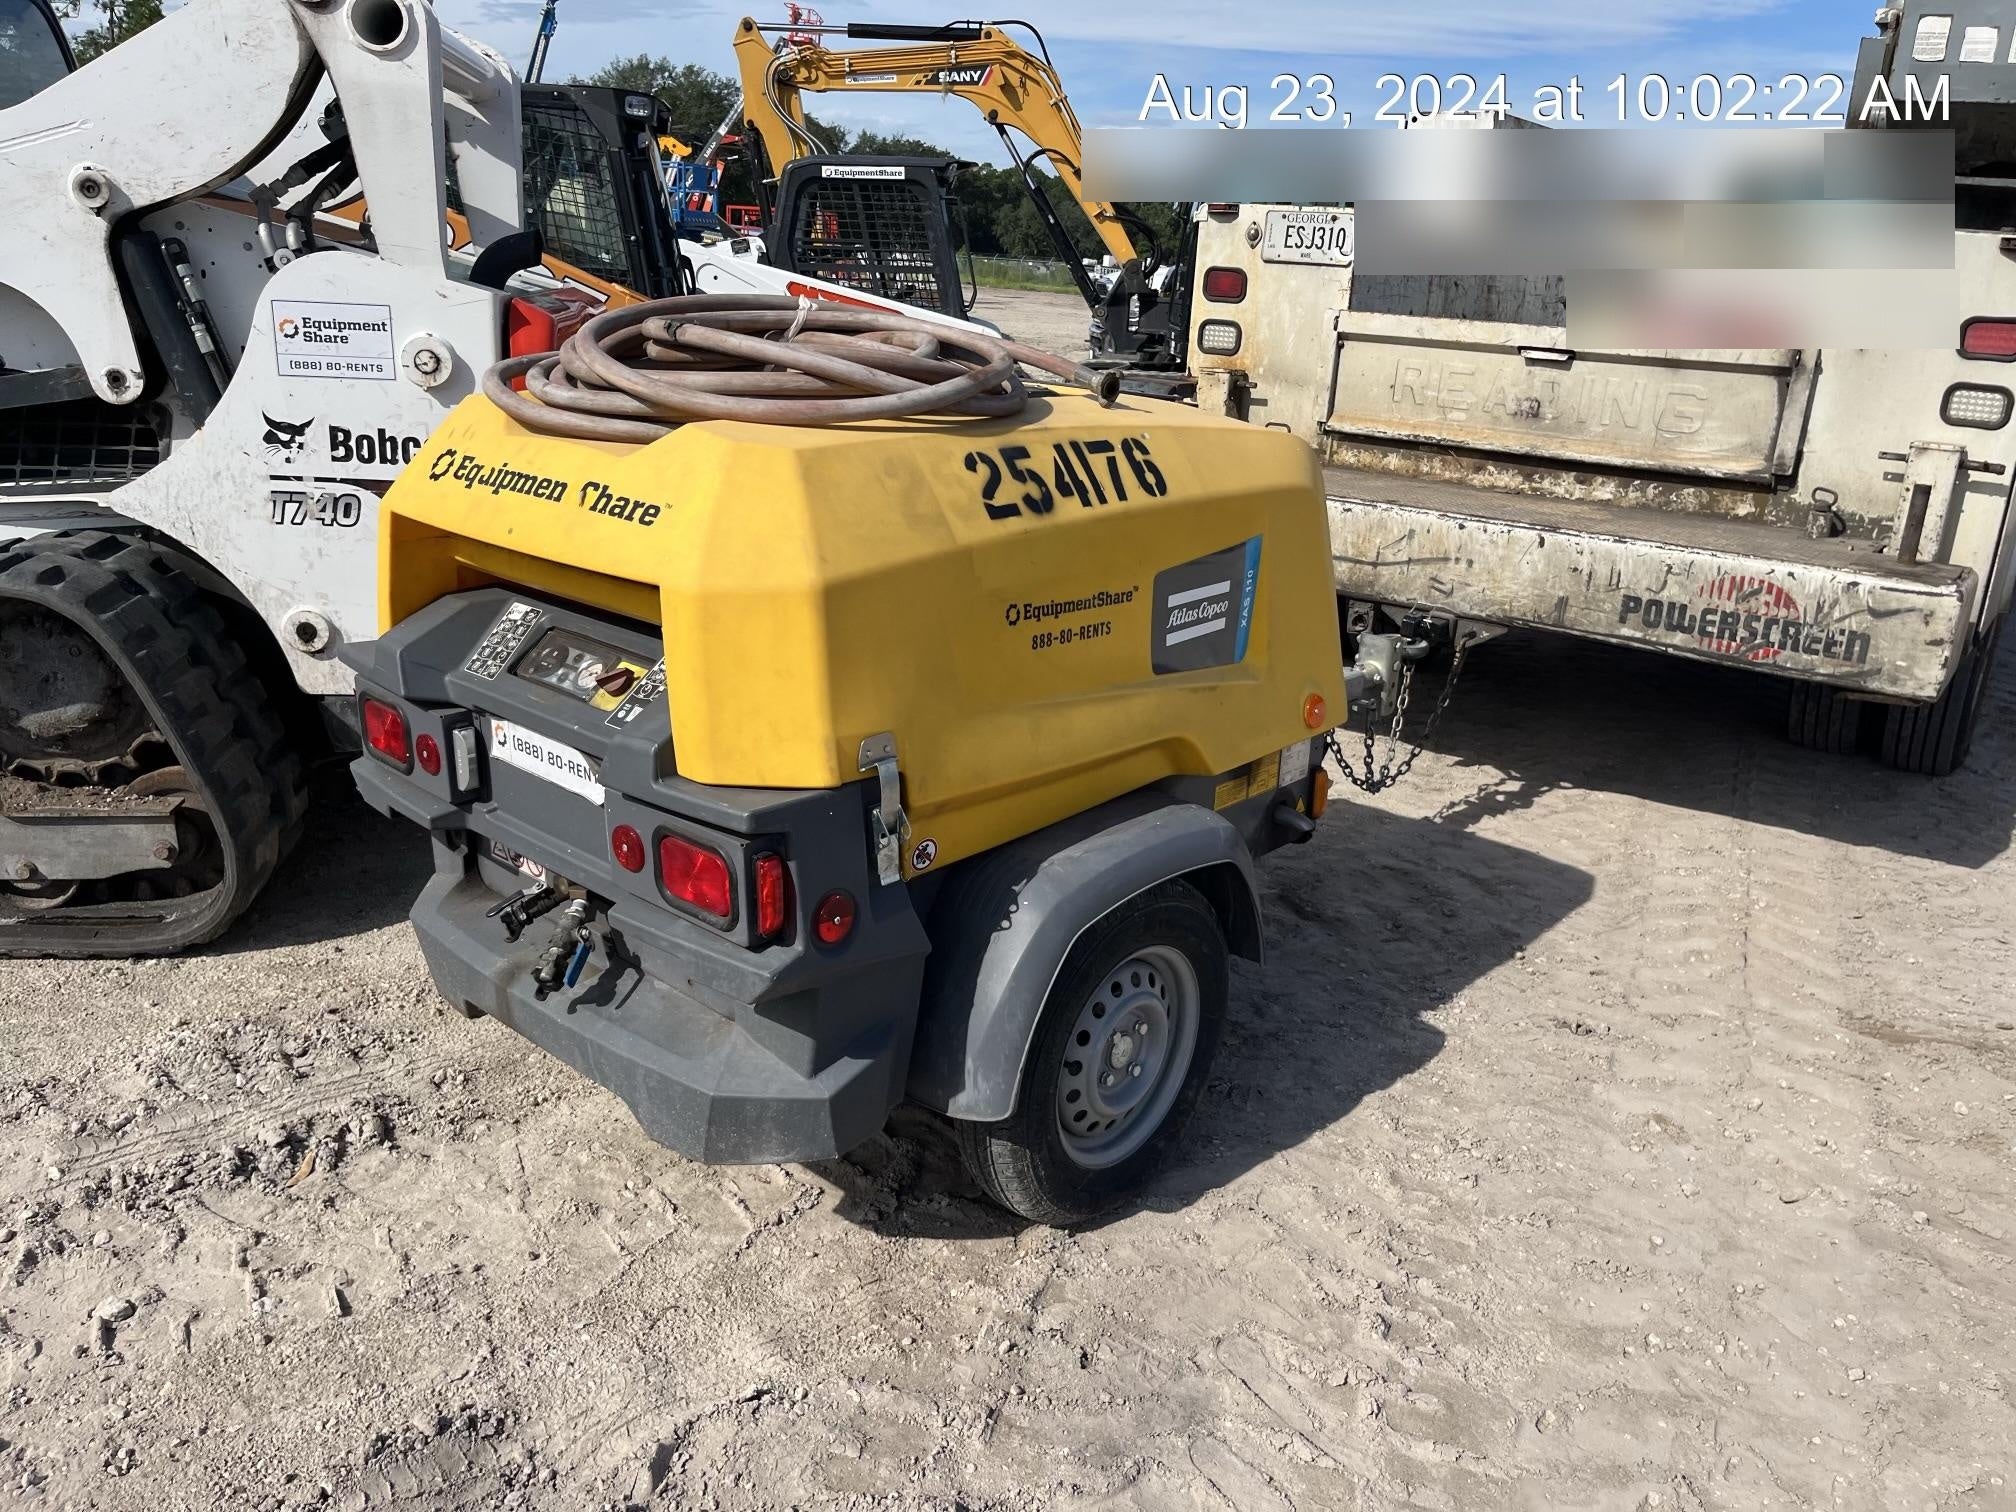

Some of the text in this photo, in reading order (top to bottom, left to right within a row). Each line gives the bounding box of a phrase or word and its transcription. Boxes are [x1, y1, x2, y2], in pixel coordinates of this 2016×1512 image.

[938, 71, 982, 83] SANY
[834, 168, 903, 177] EquipmentShare
[301, 317, 388, 333] Equipment
[303, 331, 349, 344] Share
[289, 360, 384, 373] (888) 80-RENTS
[1391, 357, 1708, 435] READING
[328, 423, 429, 466] Bobc
[964, 437, 1168, 521] 254176
[269, 489, 362, 528] T740
[1023, 588, 1133, 621] EquipmentShare
[1240, 570, 1254, 628] XAS 110
[1031, 621, 1112, 650] 888-80-RENTS
[1618, 594, 1872, 665] POWERSCREEN
[511, 734, 600, 785] (888) 80-REN
